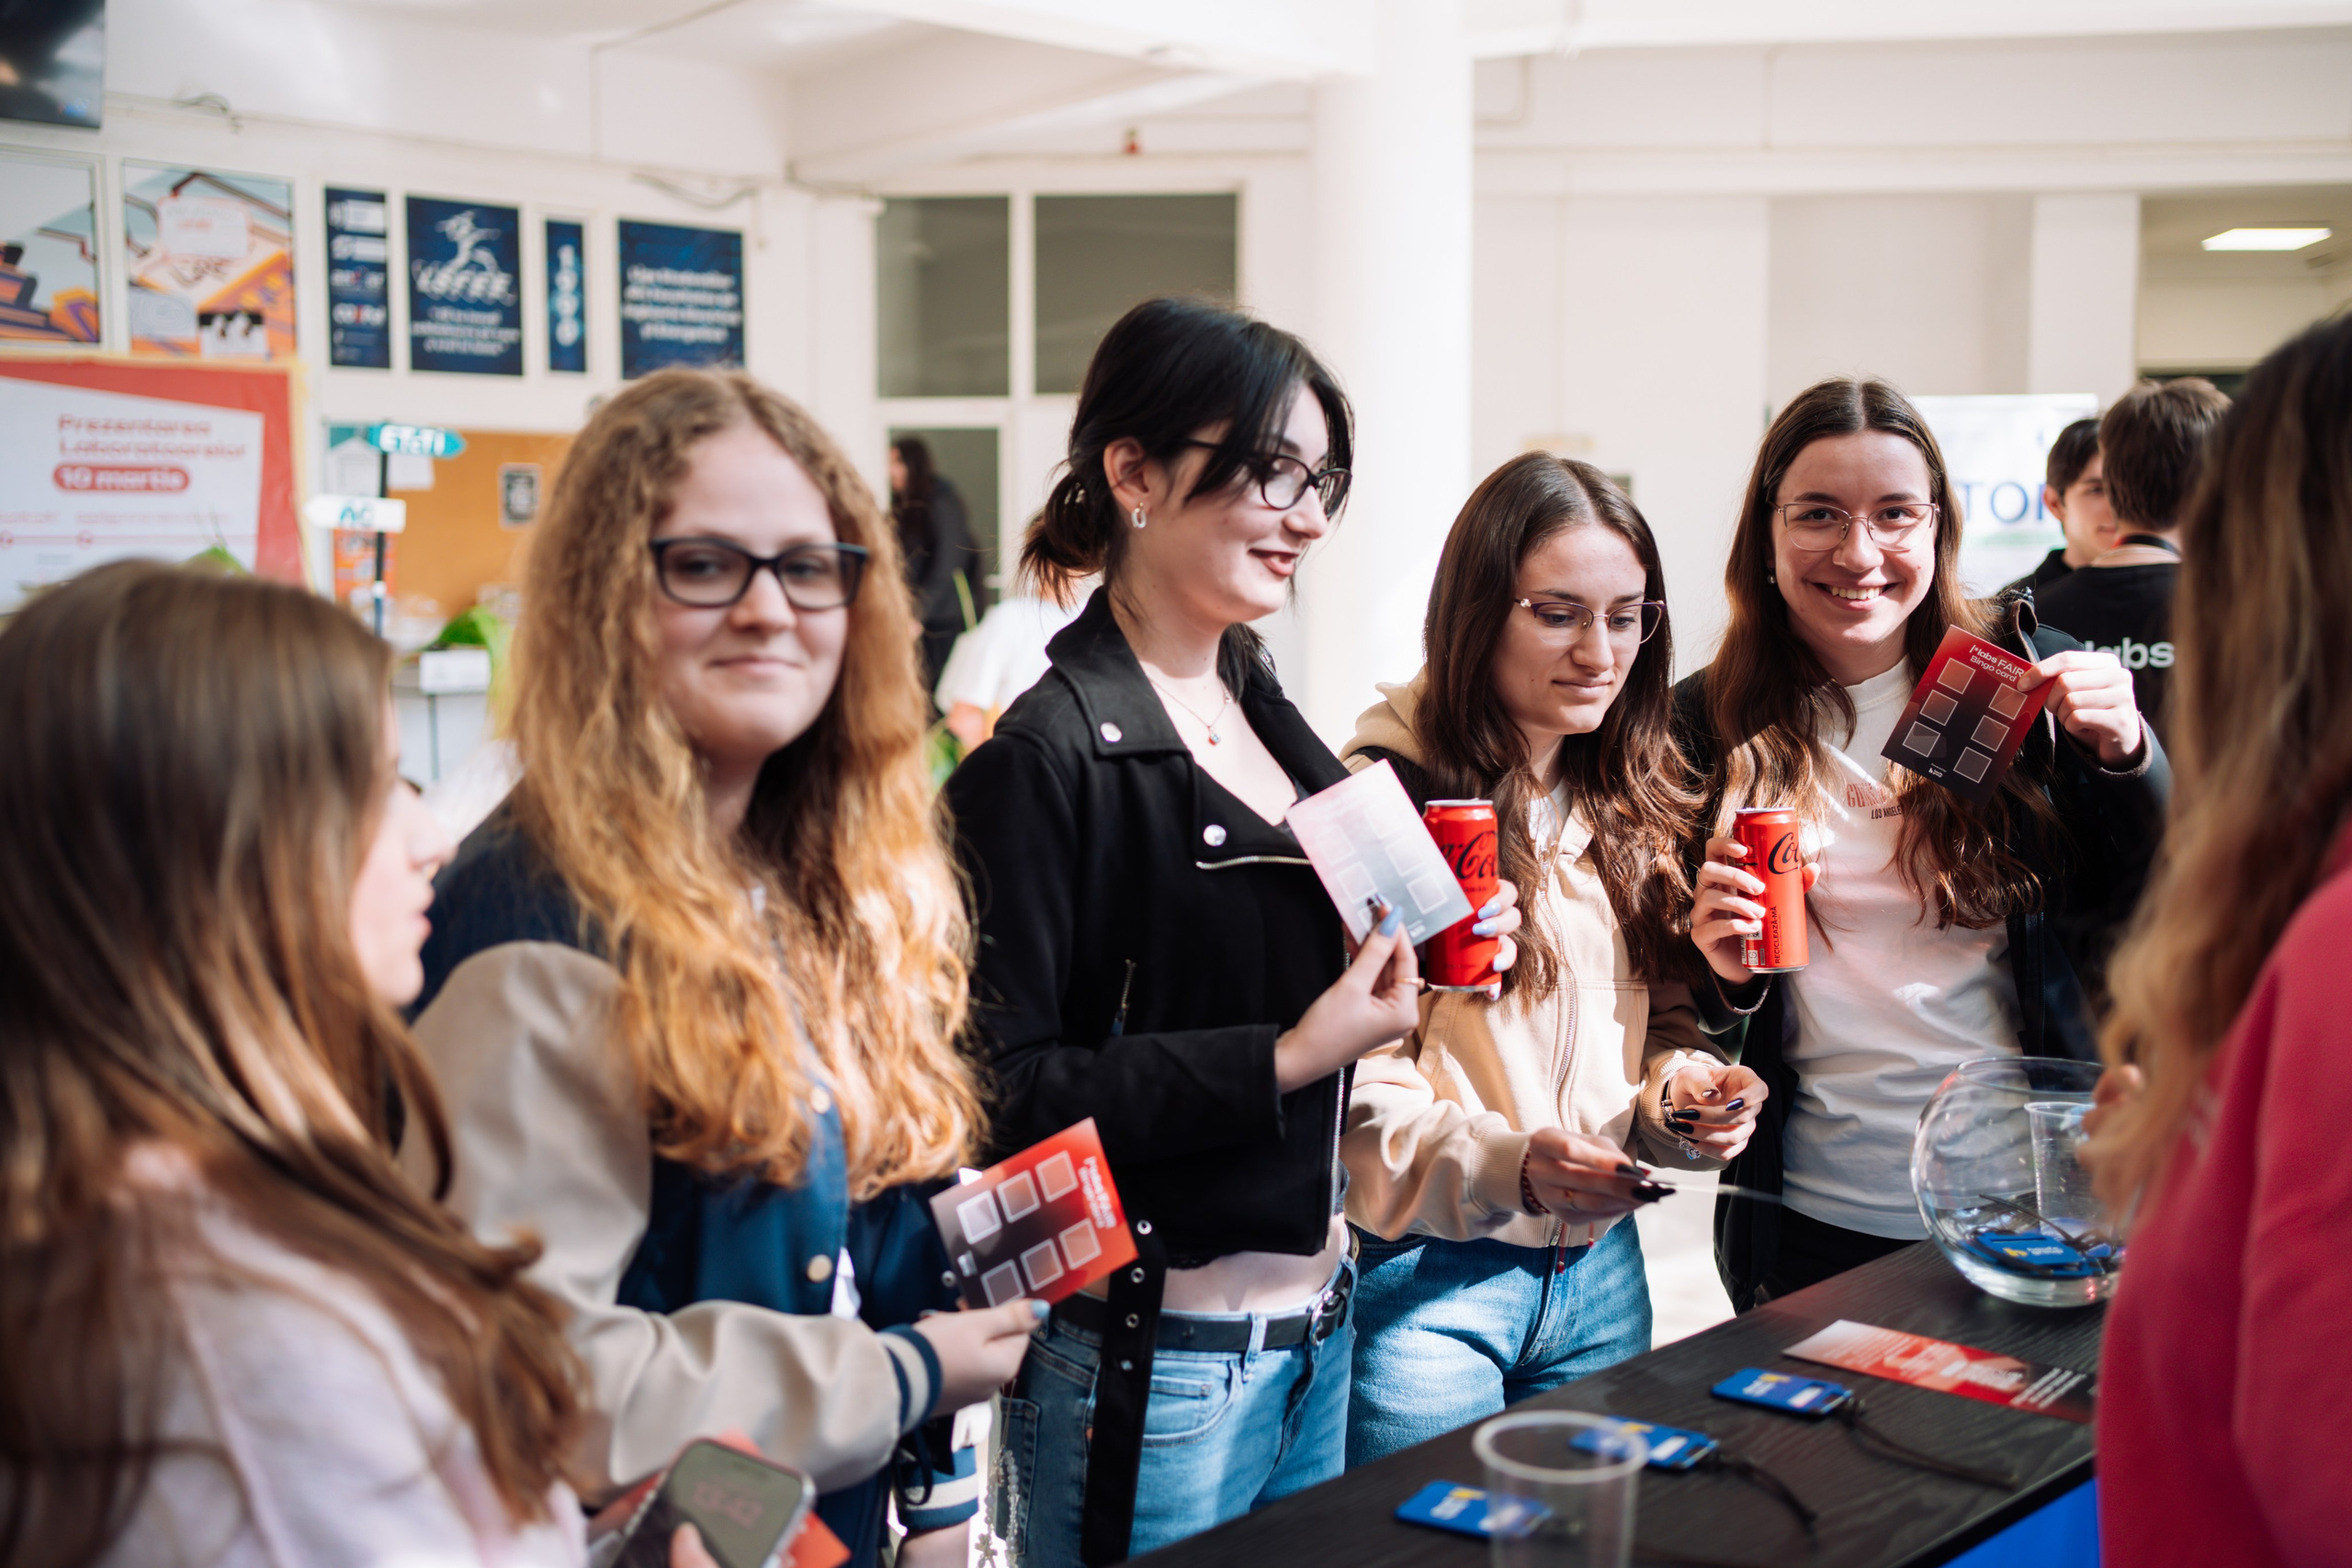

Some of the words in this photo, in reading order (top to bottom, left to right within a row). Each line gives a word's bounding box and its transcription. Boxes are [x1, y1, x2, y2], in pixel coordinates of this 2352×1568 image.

[1953, 481, 2046, 524] TO
[1970, 655, 1995, 671] Bingo
[1996, 669, 2017, 682] card
[1997, 659, 2025, 678] FAIR
[1871, 808, 1883, 819] LOS
[1883, 805, 1902, 818] ANGELE
